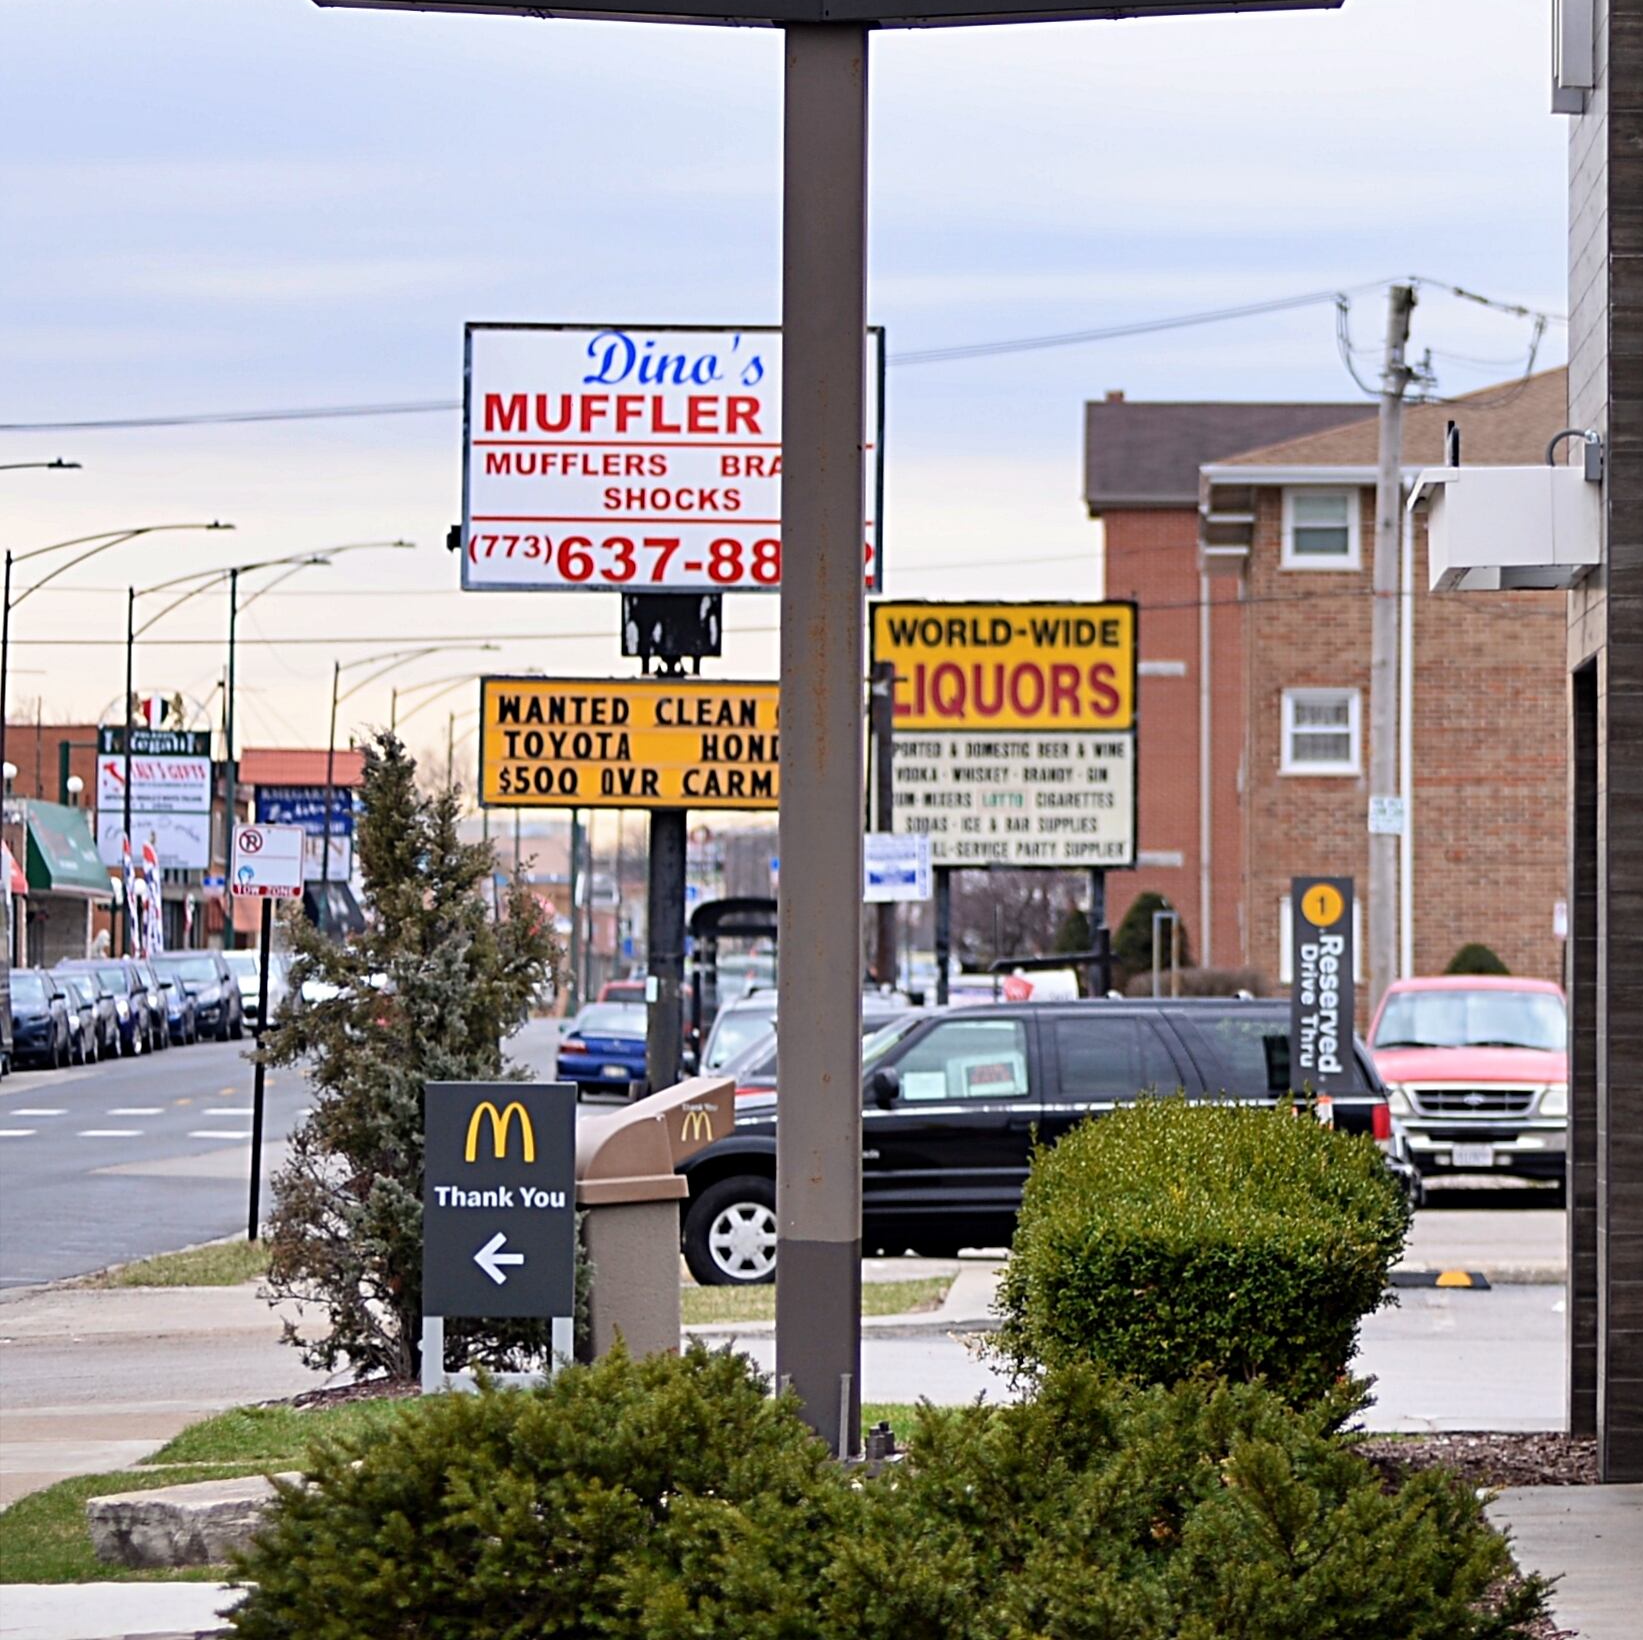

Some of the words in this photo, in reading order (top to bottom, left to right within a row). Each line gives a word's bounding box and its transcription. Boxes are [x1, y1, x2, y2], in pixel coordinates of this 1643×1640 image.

[583, 331, 765, 386] Dino's
[484, 393, 763, 435] MUFFLER
[485, 452, 668, 476] MUFFLERS
[720, 455, 783, 477] BRA
[603, 487, 742, 511] SHOCKS
[468, 534, 553, 565] (773)
[556, 535, 875, 586] 637-88
[887, 618, 1120, 648] WORLD-WIDE
[498, 695, 629, 725] WANTED
[654, 698, 757, 727] CLEAN
[503, 730, 631, 760] TOYOTA
[893, 741, 942, 758] PORTED
[965, 741, 1030, 758] DOMESTIC
[1037, 741, 1069, 758] BEER
[1093, 742, 1125, 758] WINE
[498, 766, 579, 795] $500
[681, 768, 773, 798] CARM
[952, 766, 1009, 783] WHISKEY
[1023, 766, 1073, 783] BRANDY
[1035, 792, 1115, 809] CIGARETTES
[1038, 816, 1098, 833] SUPPLIES
[1016, 842, 1057, 858] PARTY
[1064, 842, 1124, 859] SUPPLIER
[1300, 943, 1319, 1006] Drive
[1318, 934, 1345, 1074] Reserved
[1299, 1012, 1319, 1068] Thru
[433, 1185, 514, 1208] Thank
[519, 1186, 566, 1208] You
